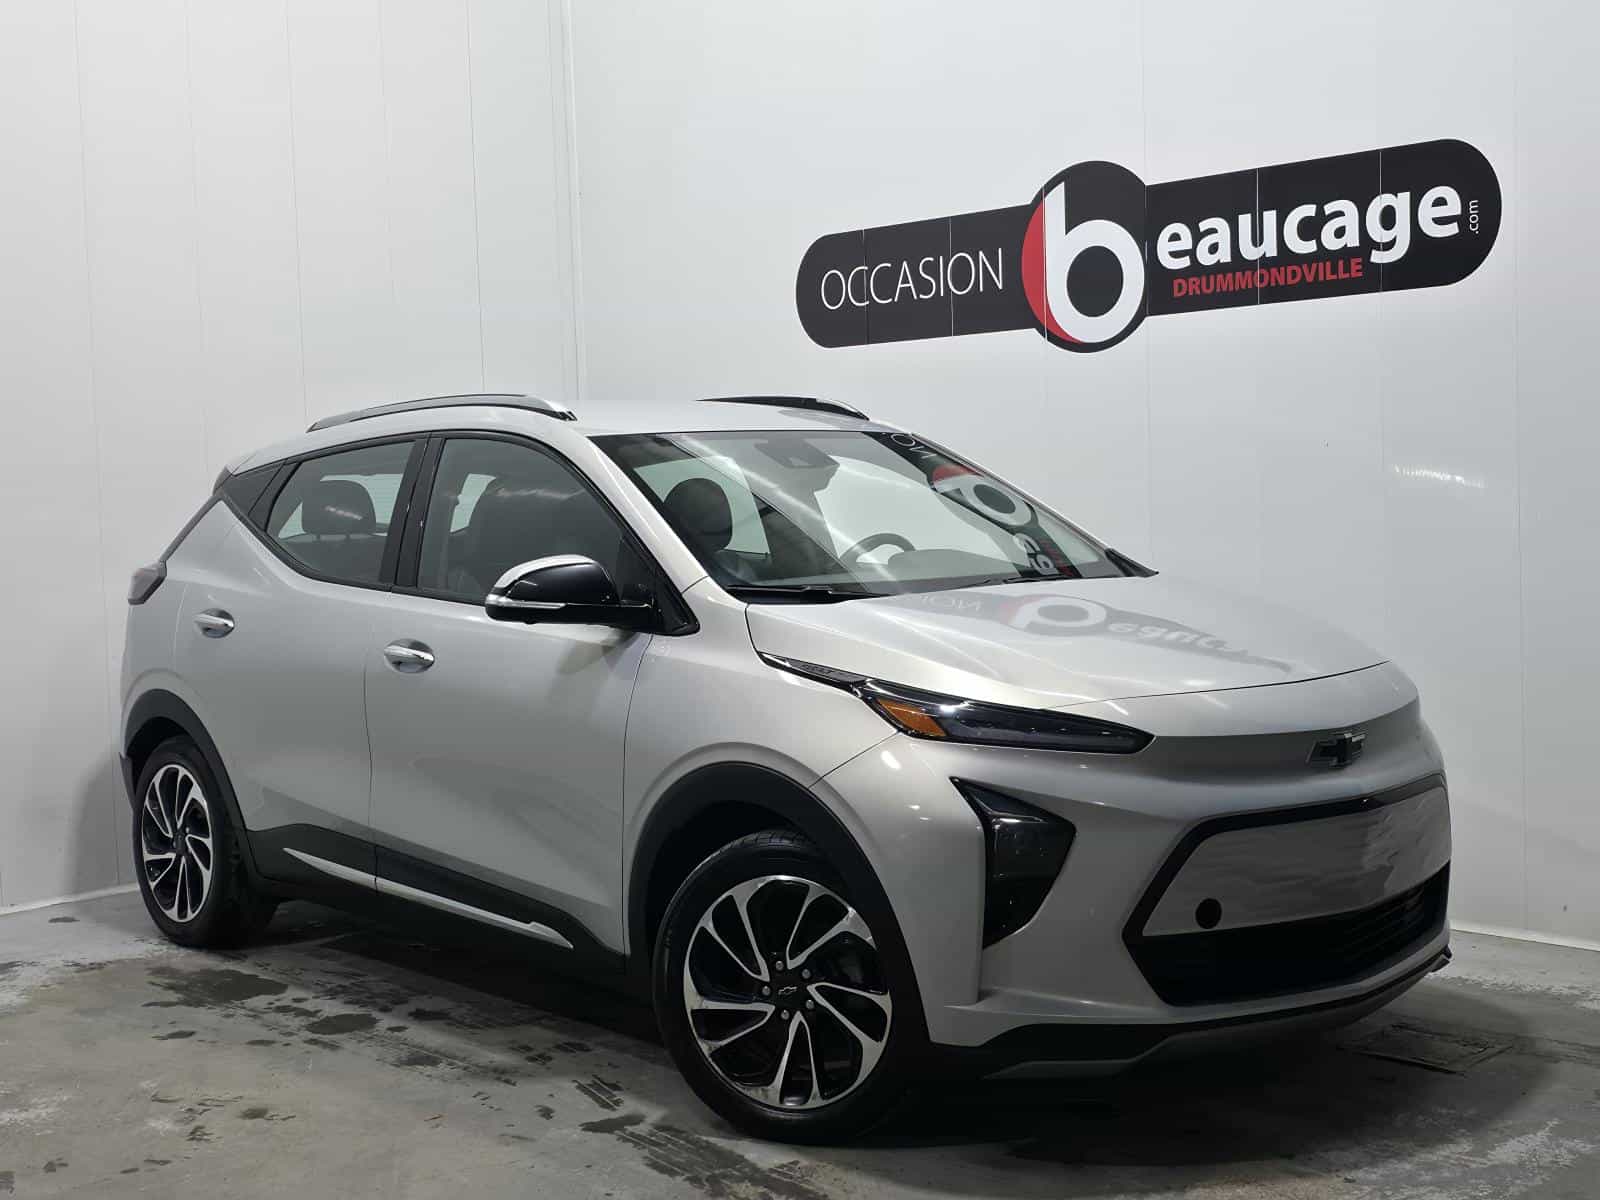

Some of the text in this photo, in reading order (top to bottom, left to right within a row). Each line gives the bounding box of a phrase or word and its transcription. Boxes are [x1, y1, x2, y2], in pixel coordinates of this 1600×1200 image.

[1468, 199, 1480, 235] .com
[821, 248, 1003, 310] OCCASION
[1043, 181, 1462, 344] beaucage
[1172, 257, 1364, 299] DRUMMONDVILLE
